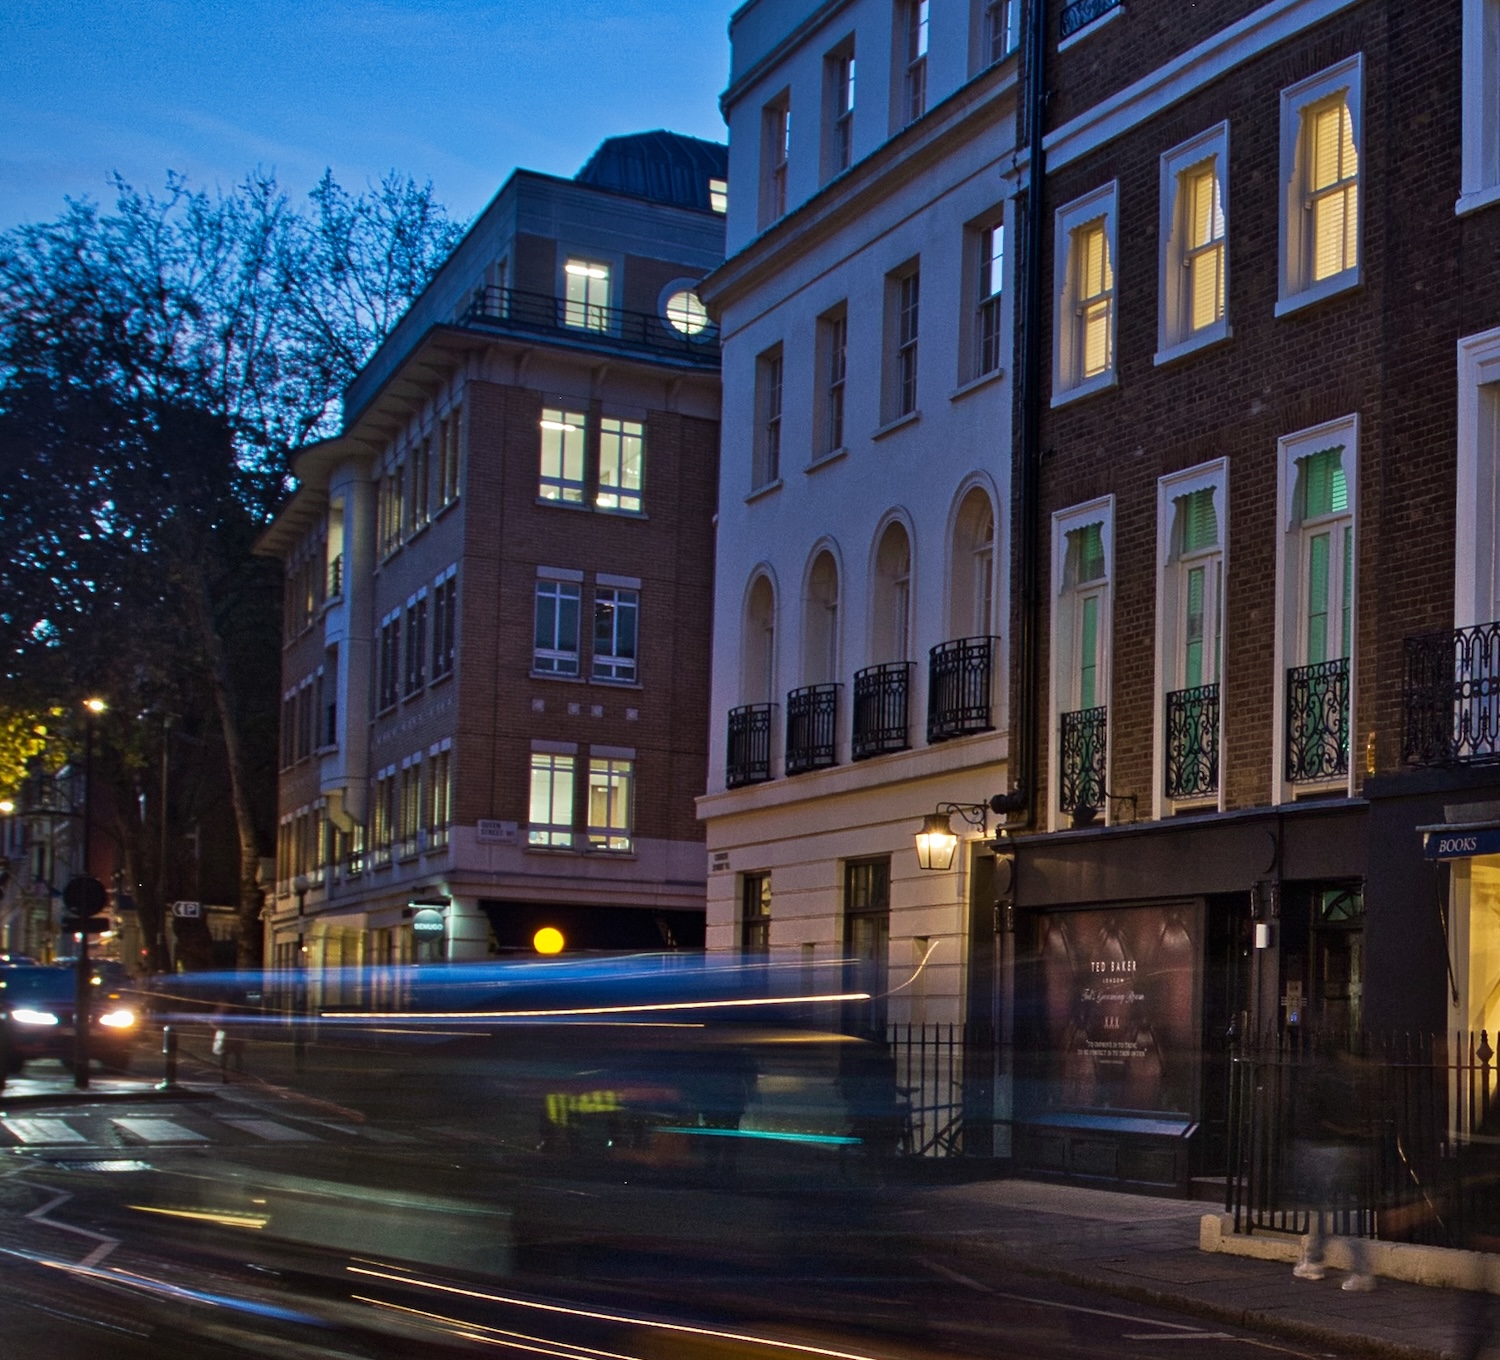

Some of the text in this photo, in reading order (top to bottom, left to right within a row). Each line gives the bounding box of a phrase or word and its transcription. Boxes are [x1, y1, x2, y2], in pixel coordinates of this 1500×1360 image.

[1439, 837, 1477, 853] BOOKS
[1091, 960, 1136, 972] TED BAKER
